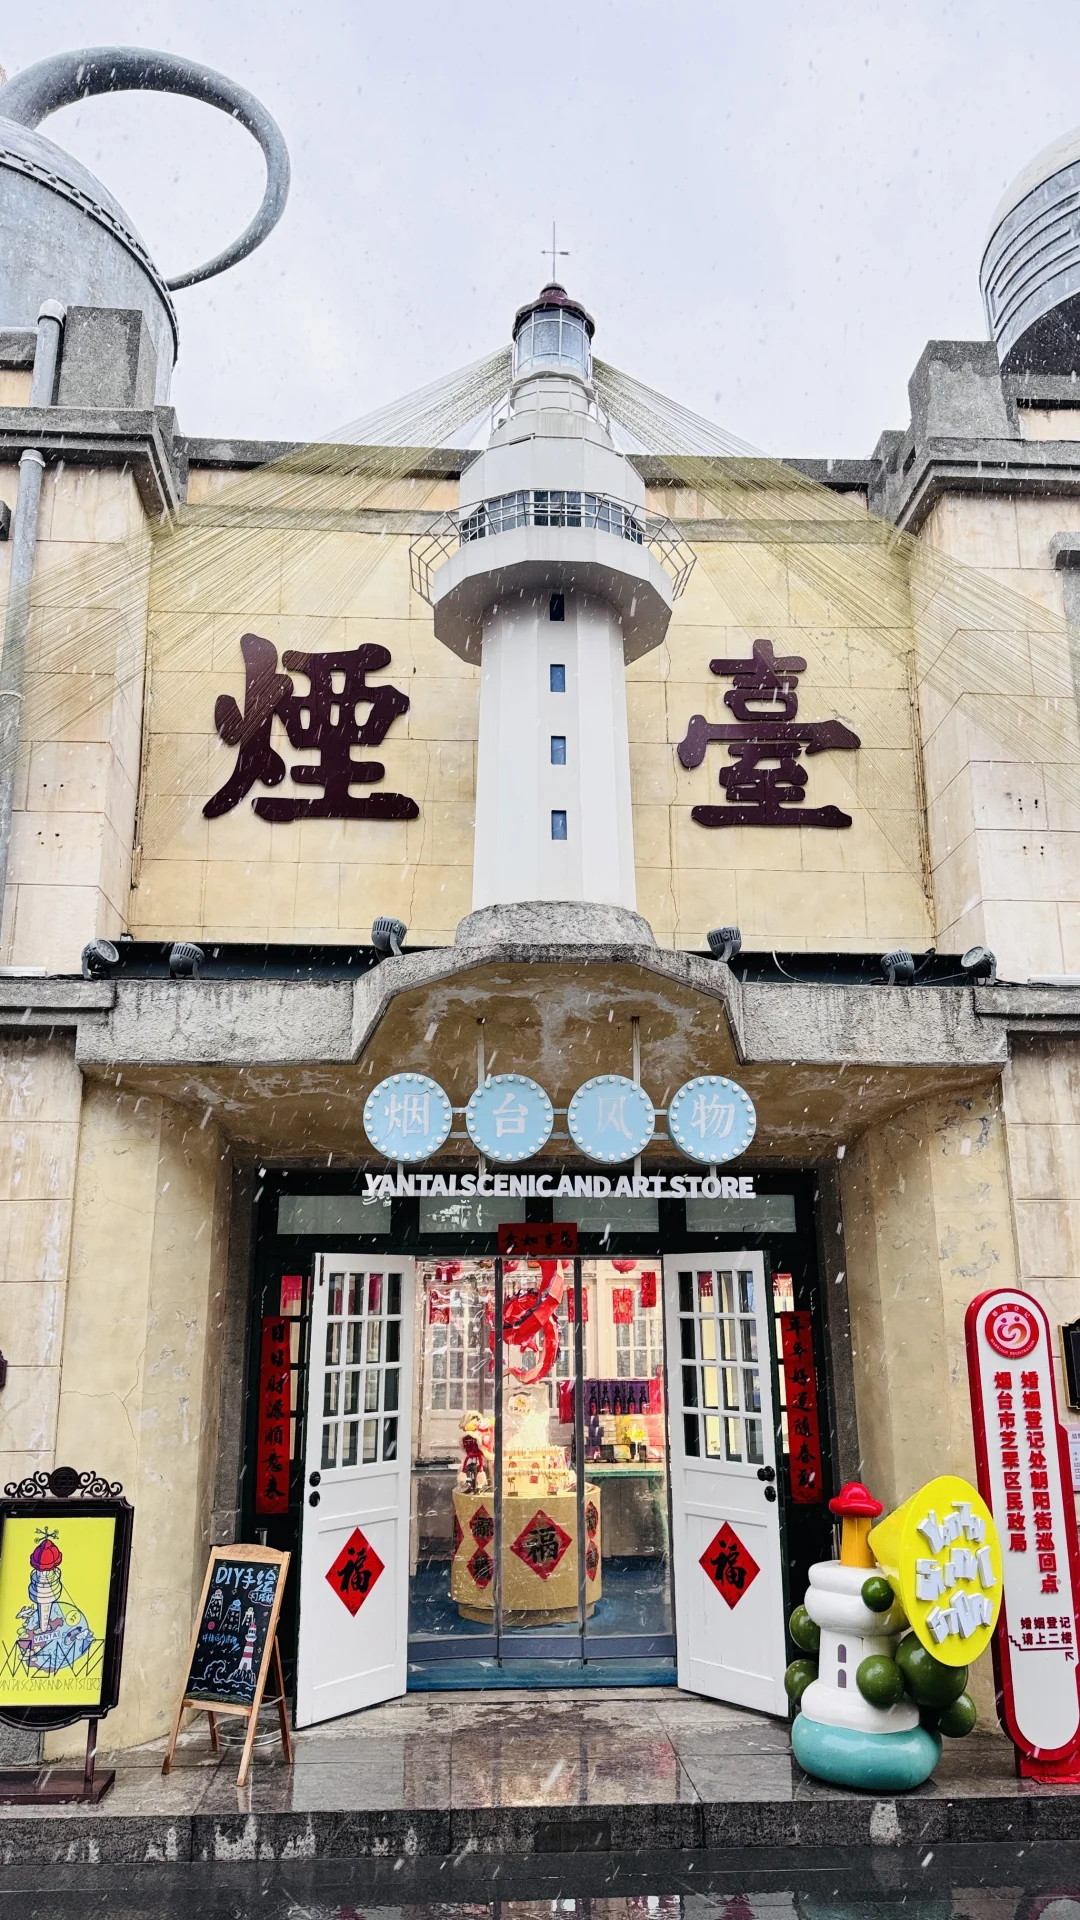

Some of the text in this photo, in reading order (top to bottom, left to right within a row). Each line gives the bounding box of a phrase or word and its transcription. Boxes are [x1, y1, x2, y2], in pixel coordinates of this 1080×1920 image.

[385, 1091, 735, 1140] 烟台风物
[365, 1173, 757, 1199] YANTAI SCENIC AND ART STORE
[994, 1371, 1027, 1552] 烟台市芝罘区民政局
[1021, 1371, 1059, 1594] 婚姻登记处朝阳街巡回点
[526, 1526, 559, 1563] 福
[710, 1540, 747, 1590] 福
[337, 1547, 372, 1594] 福
[1020, 1616, 1071, 1630] 婚姻登记
[1022, 1631, 1072, 1646] 请上二楼
